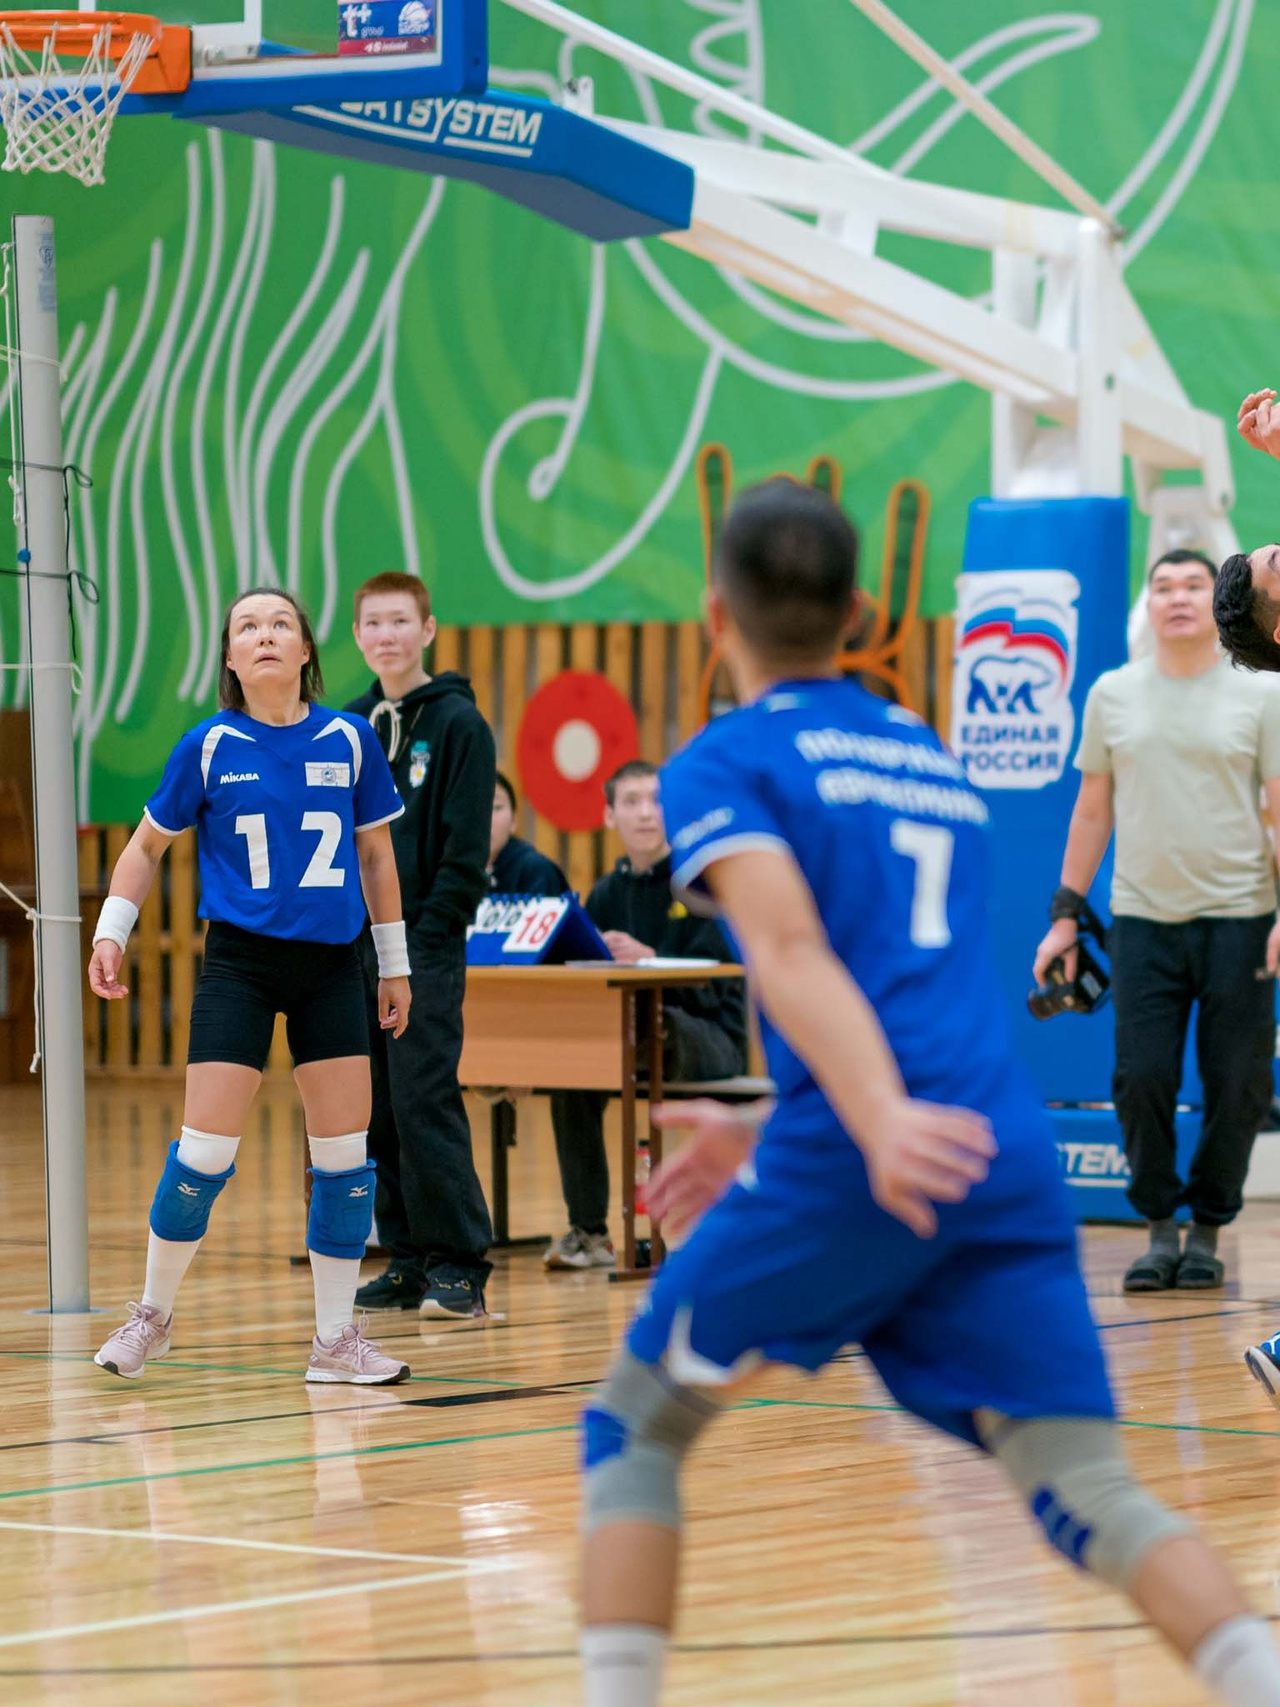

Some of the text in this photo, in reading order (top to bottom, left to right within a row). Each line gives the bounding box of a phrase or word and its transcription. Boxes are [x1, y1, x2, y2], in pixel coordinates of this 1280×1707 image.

[961, 724, 1059, 745] ЕДИНАЯ
[962, 751, 1059, 771] РОССИЯ
[235, 811, 346, 890] 12
[515, 910, 558, 945] 18
[1056, 1142, 1131, 1176] TEM
